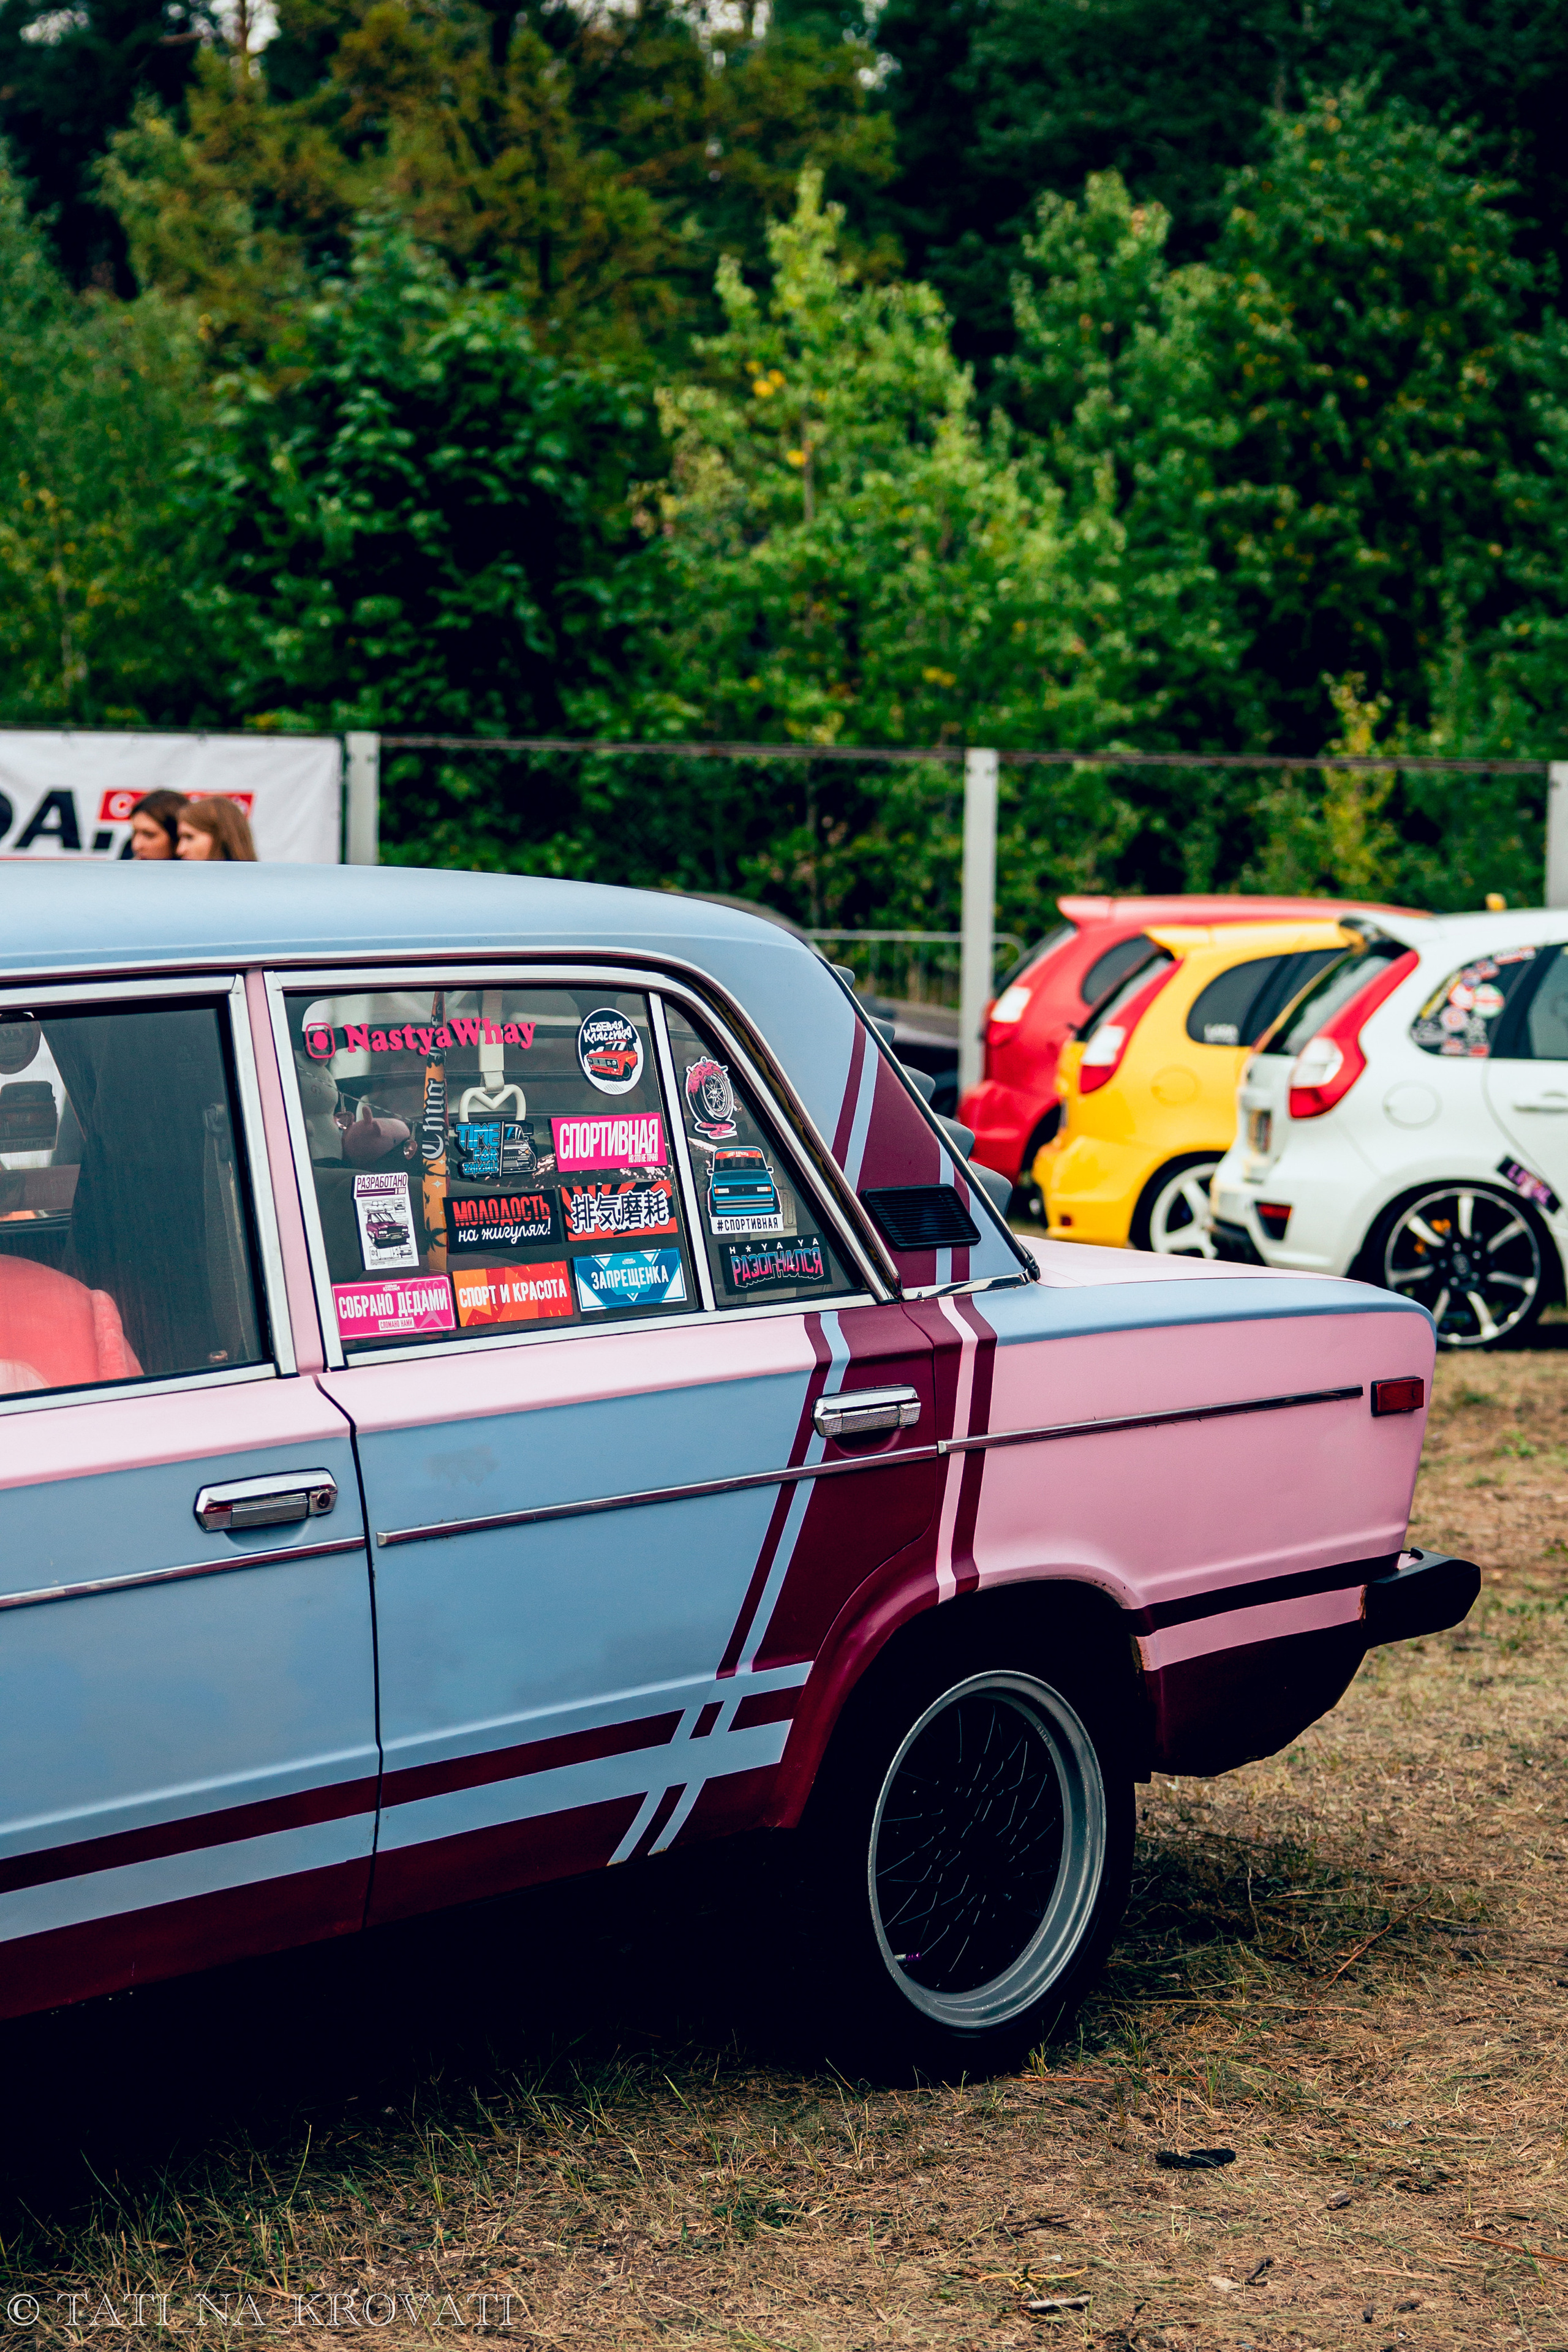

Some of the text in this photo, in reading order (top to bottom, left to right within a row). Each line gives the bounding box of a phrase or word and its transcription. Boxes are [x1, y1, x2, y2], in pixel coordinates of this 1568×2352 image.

[344, 1017, 536, 1055] NastyaWhay
[583, 1025, 633, 1044] КЛАССИКА
[589, 1020, 624, 1033] БОЕВАЯ
[456, 1123, 500, 1150] TIME
[559, 1118, 658, 1159] СПОРТИВНАЯ
[473, 1148, 499, 1162] FOR
[357, 1174, 407, 1190] РАЗРАБОТАНО
[462, 1162, 499, 1177] ZHIGULI
[453, 1195, 551, 1227] МОЛОДОСТЬ
[571, 1189, 668, 1233] 排気磨耗
[717, 1217, 778, 1231] #СПОРТИВНАЯ
[458, 1218, 551, 1245] на жигулях!
[591, 1264, 669, 1291] ЗАПРЕЩЕНКА
[731, 1247, 824, 1286] РАЗОГНАЛСЯ
[338, 1288, 448, 1319] СОБРАНО ДЕДАМИ
[459, 1278, 567, 1308] СПОРТ И КРАСОТА
